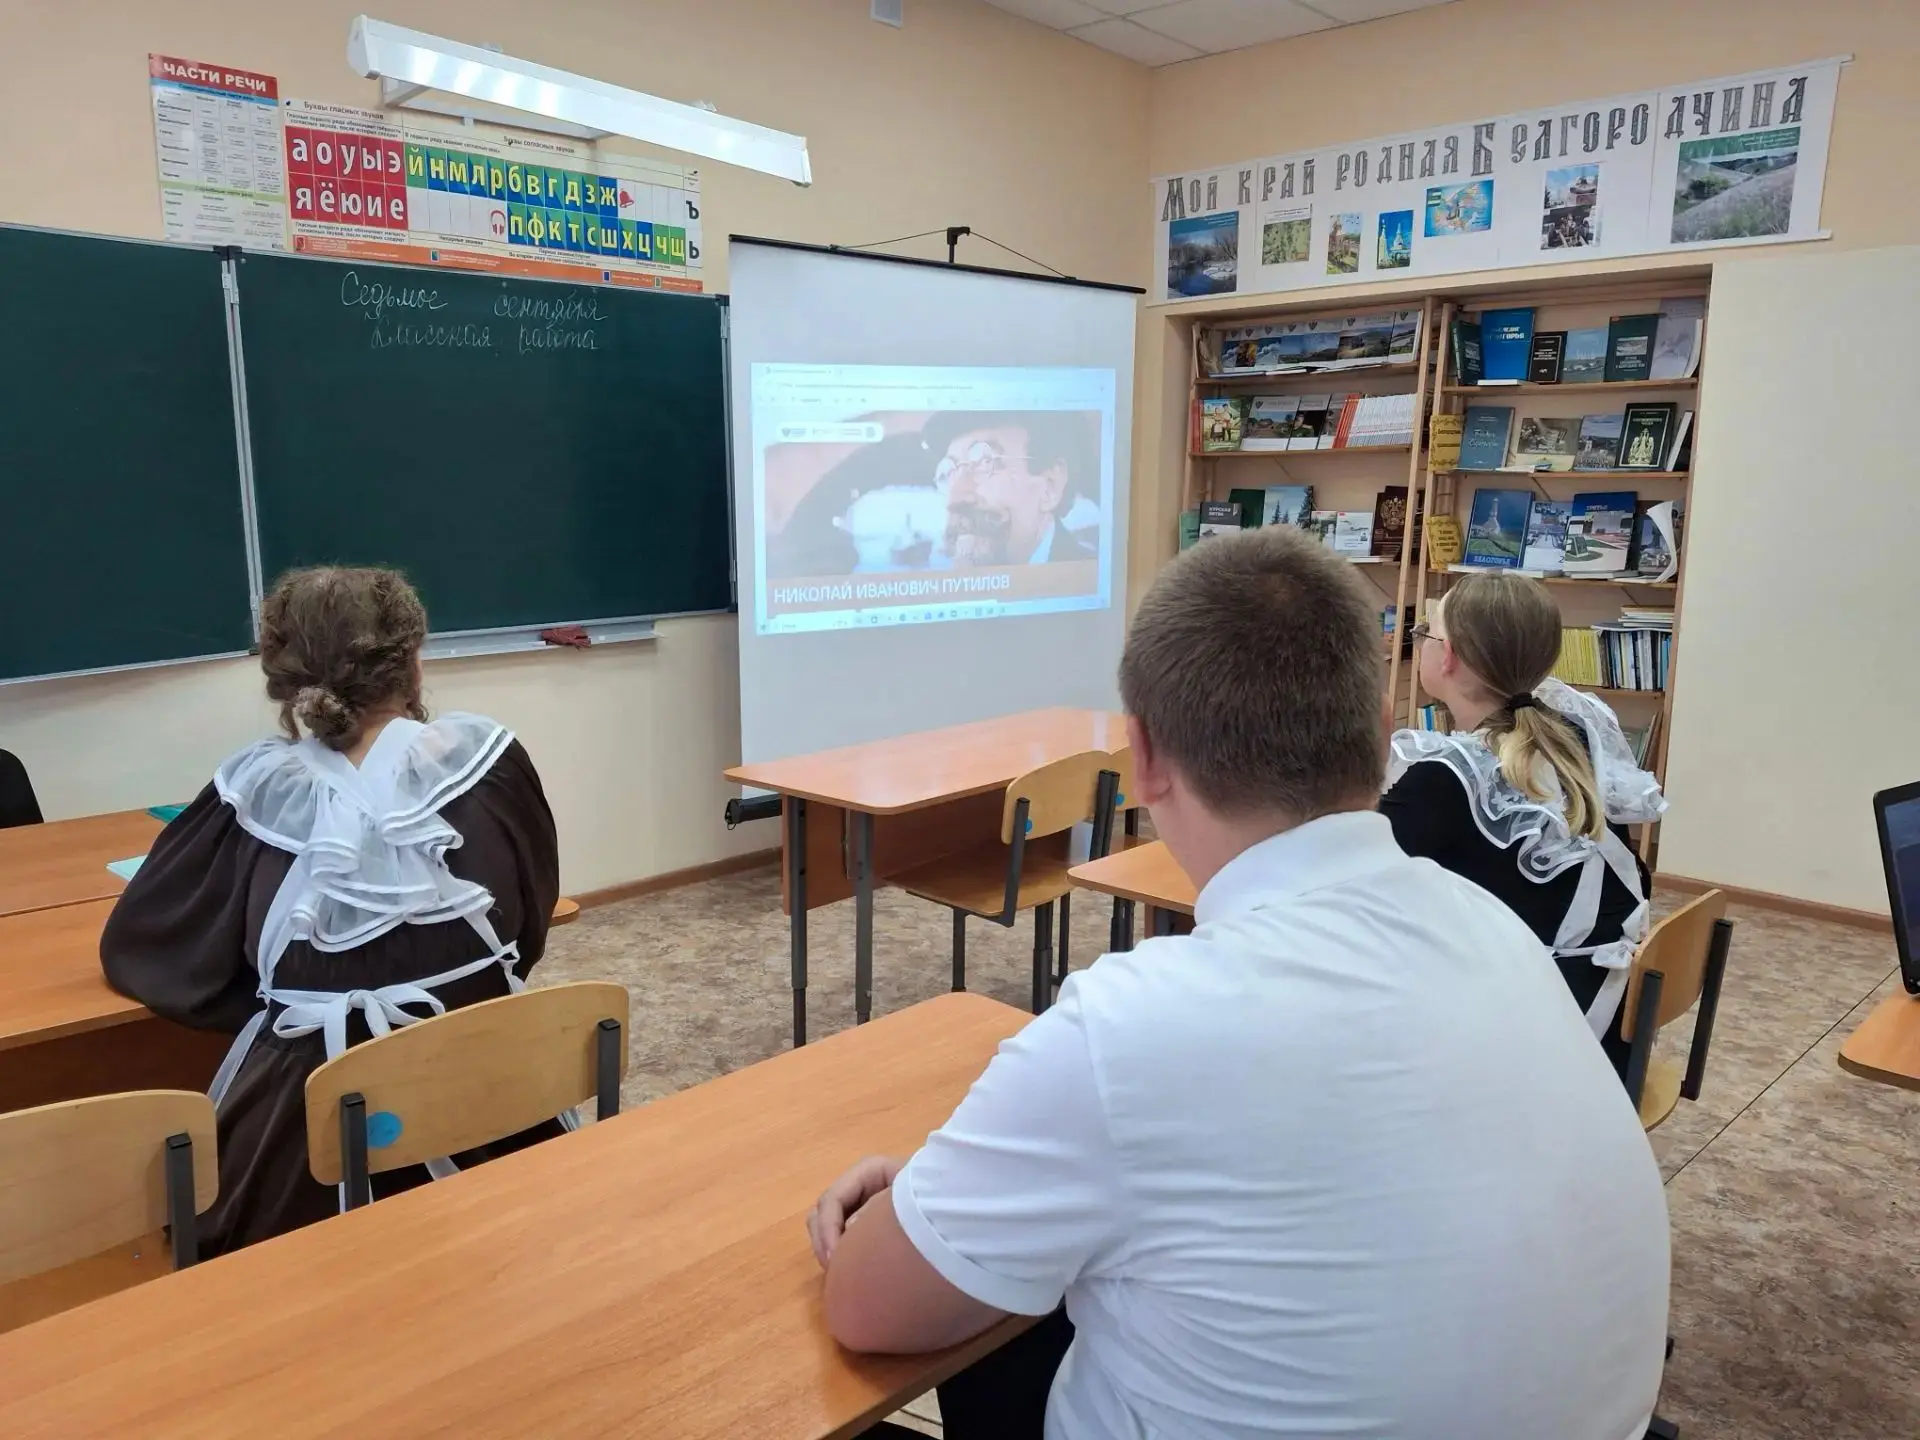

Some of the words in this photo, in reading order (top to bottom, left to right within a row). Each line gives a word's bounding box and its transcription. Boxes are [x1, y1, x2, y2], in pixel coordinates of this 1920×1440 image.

[163, 62, 220, 84] ЧАСТИ
[224, 73, 266, 92] РЕЧИ
[341, 271, 449, 319] Седьмое
[773, 581, 852, 604] НИКОЛАЙ
[857, 579, 938, 600] ИВАНОВИЧ
[942, 574, 1010, 594] ПУТИЛОВ
